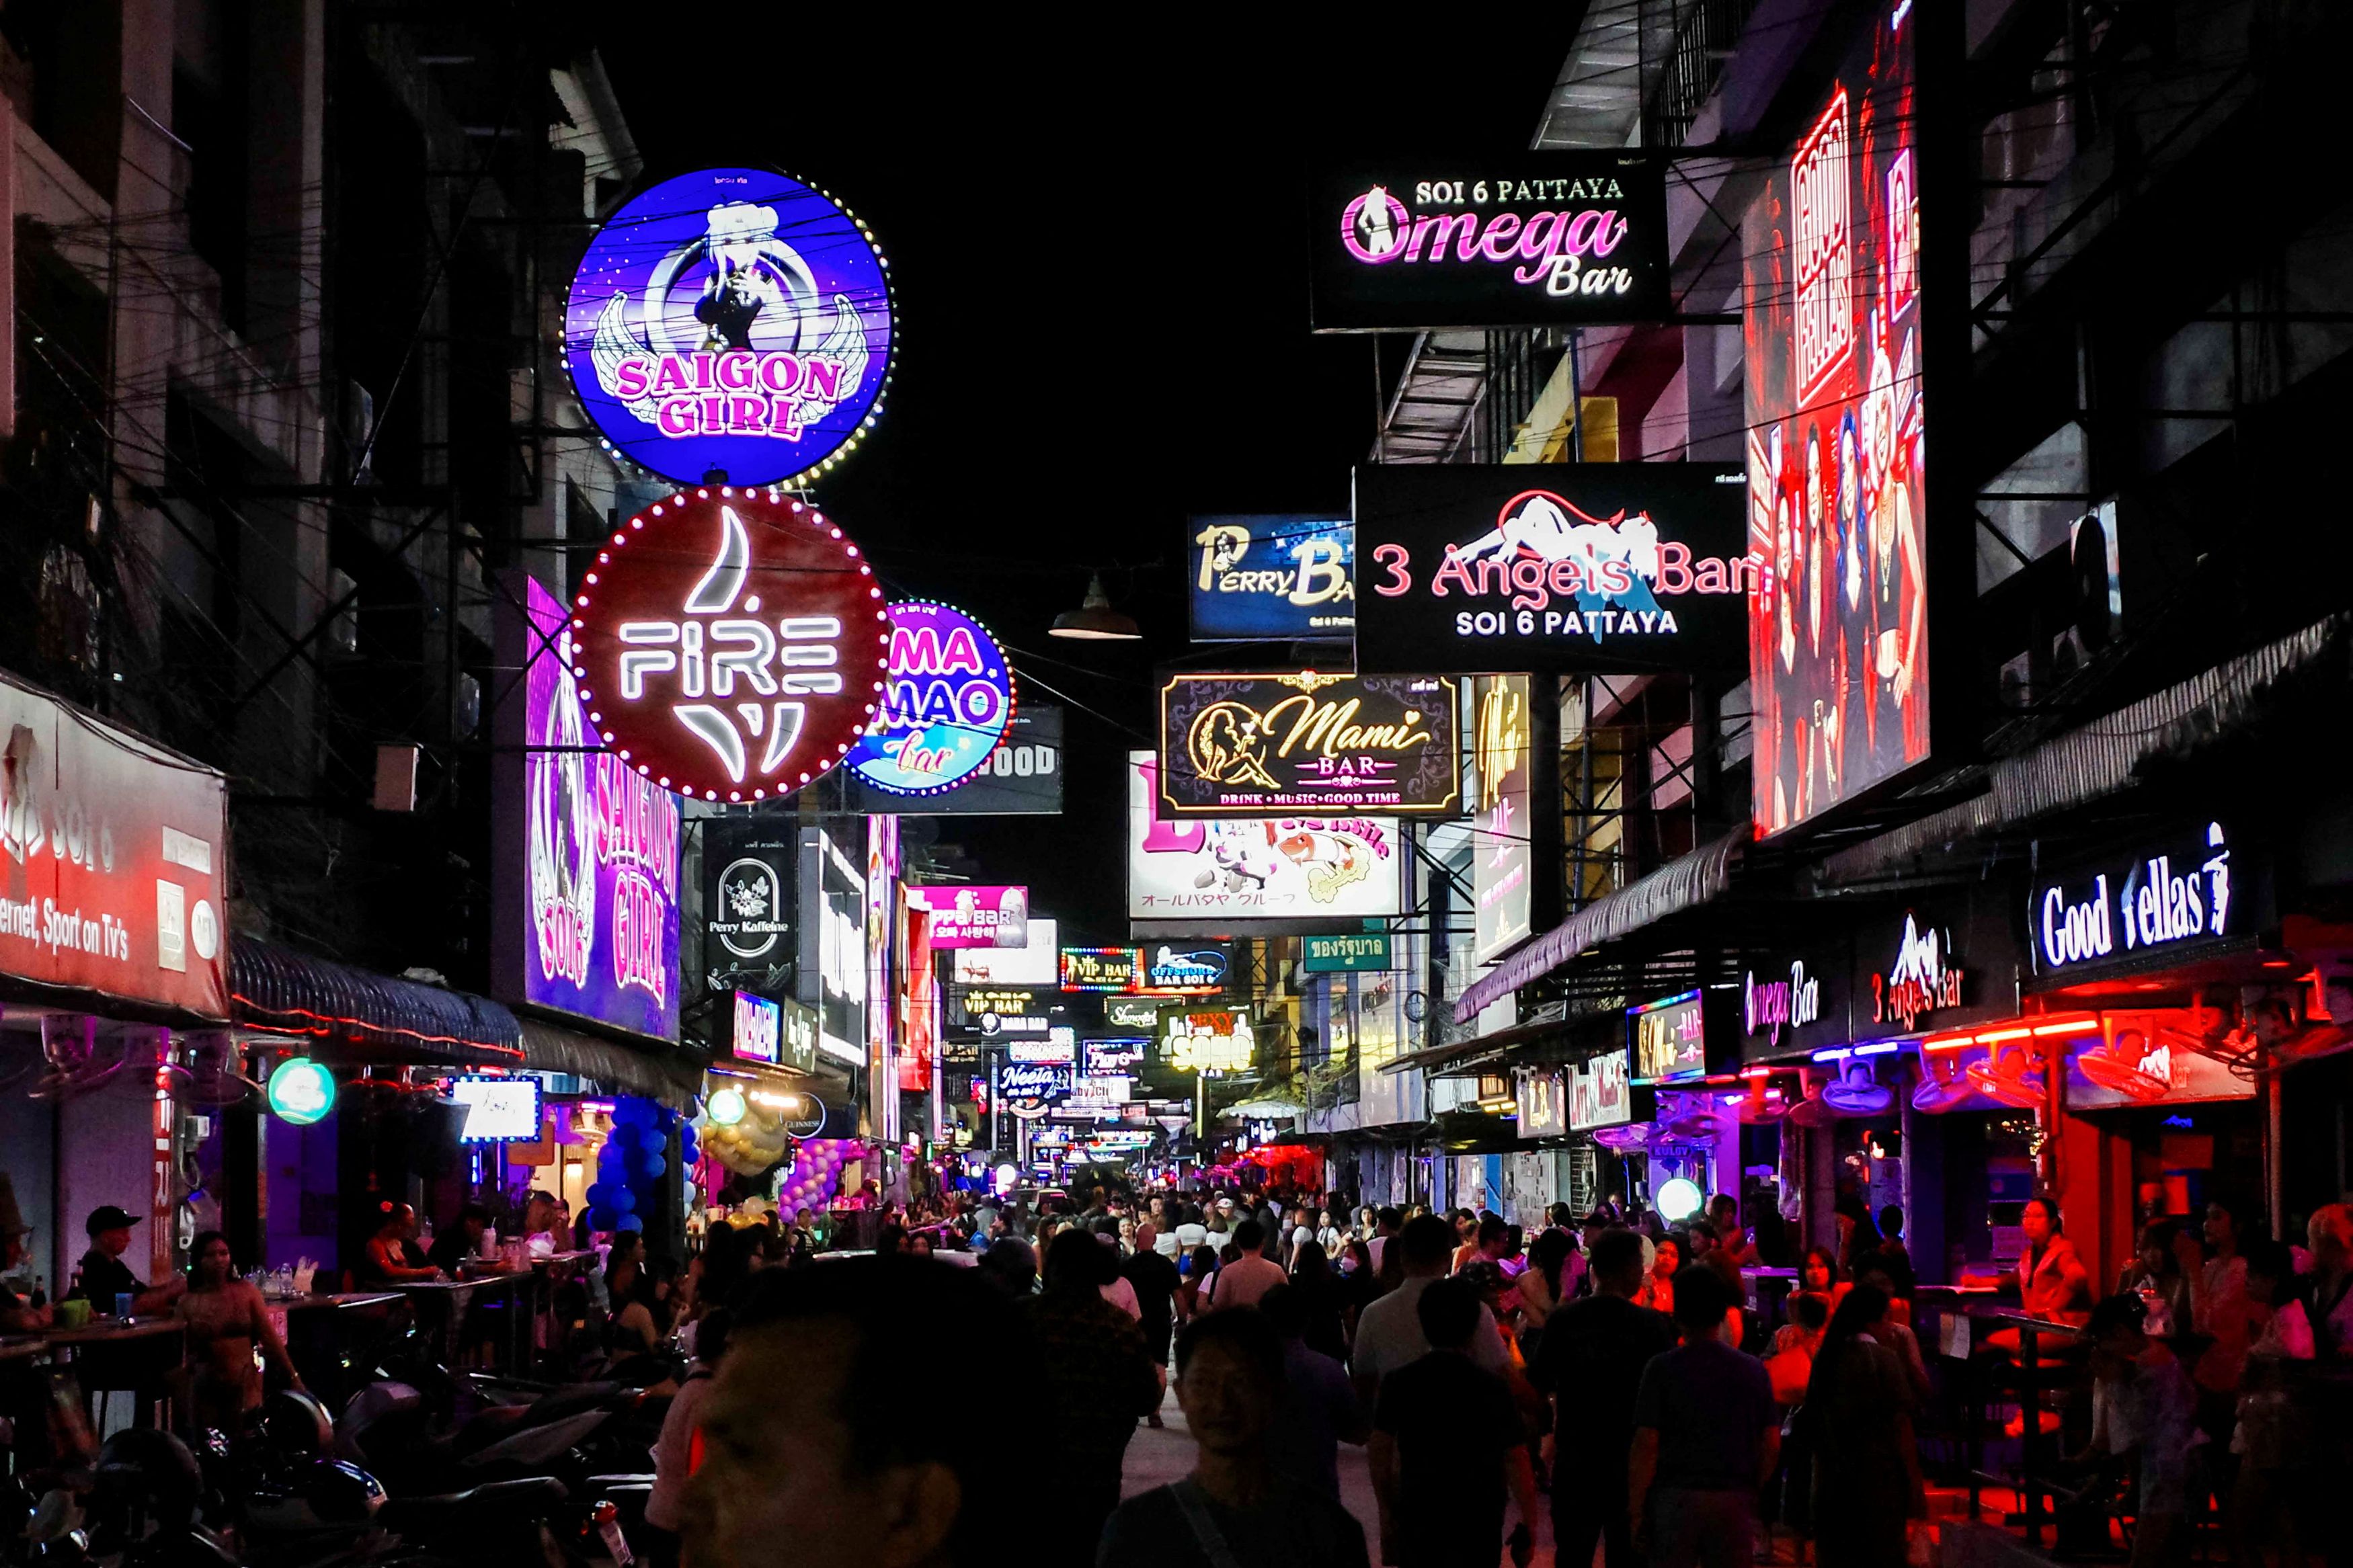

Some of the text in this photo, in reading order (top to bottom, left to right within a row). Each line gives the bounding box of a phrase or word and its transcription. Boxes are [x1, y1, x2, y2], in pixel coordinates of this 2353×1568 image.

[1416, 177, 1624, 203] SOI 6 PATTAYA
[1341, 191, 1628, 284] Omega
[1548, 254, 1632, 297] Bar
[613, 350, 846, 403] SAIGON
[656, 393, 803, 442] GIRL
[1289, 537, 1355, 606] BA
[1373, 541, 1749, 612] 3 Angels Bar
[1457, 610, 1678, 635] SOI 6 PATTAYA
[619, 616, 842, 700] FIRE
[889, 627, 985, 676] MA
[874, 679, 1004, 729] MAO
[1261, 694, 1431, 759] Mami
[883, 729, 955, 774] bar
[978, 745, 1055, 777] OOD
[1318, 756, 1378, 776] BAR
[1220, 792, 1401, 805] DRINK MUSIC GOOD TIME
[43, 897, 81, 955] Sport
[83, 917, 99, 954] on
[102, 912, 129, 962] Tv's
[612, 871, 665, 1010] GIRL
[710, 920, 789, 937] Perry Kaffeine
[2043, 874, 2112, 966] Good
[1078, 963, 1131, 977] VIP BAR
[1150, 967, 1214, 976] OFFSHORE
[1155, 975, 1181, 985] BAR
[1183, 975, 1205, 984] SOI
[964, 999, 1023, 1014] VIP BAR
[1792, 960, 1819, 1028] Bar
[1872, 973, 1882, 1023] 3
[1681, 1009, 1700, 1040] BAR
[785, 1120, 820, 1128] GUINNESS
